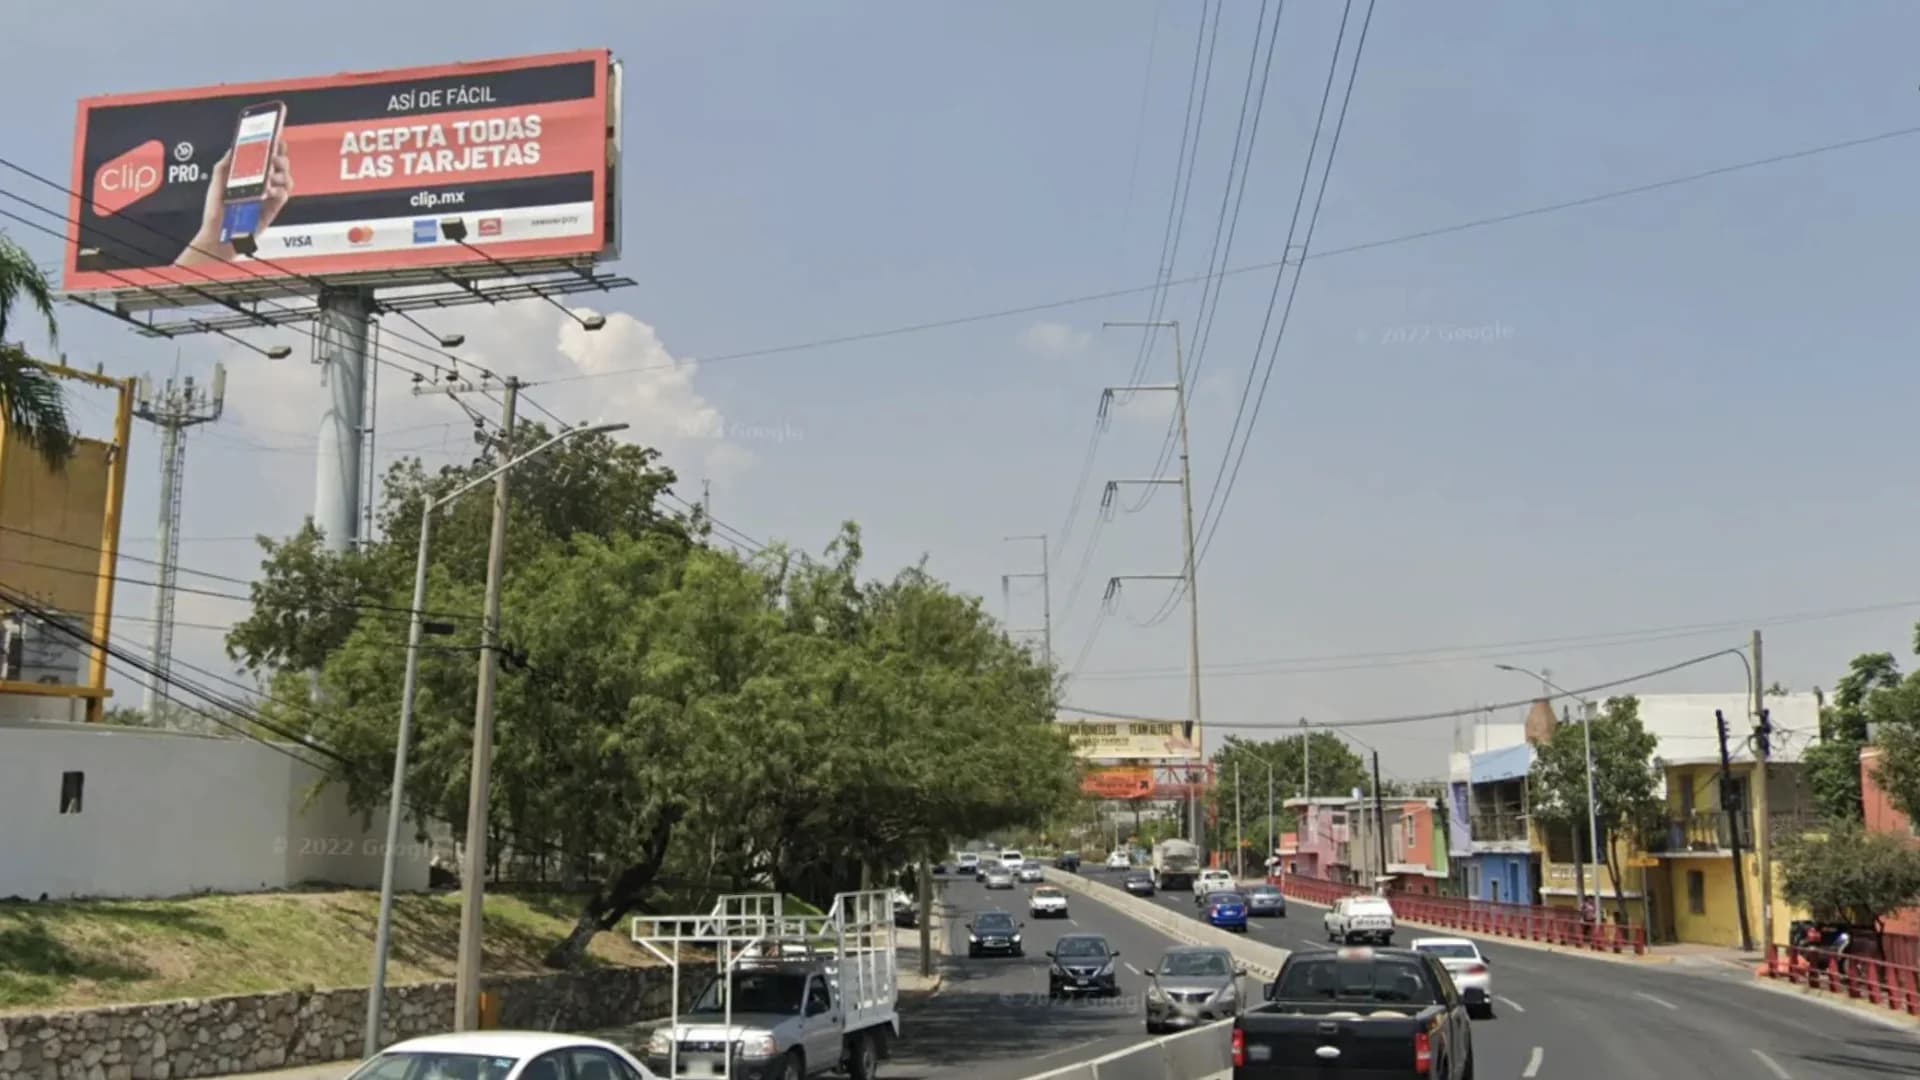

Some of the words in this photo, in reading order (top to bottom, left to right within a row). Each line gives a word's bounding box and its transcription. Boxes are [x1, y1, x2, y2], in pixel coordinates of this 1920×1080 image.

[387, 90, 415, 111] ASÍ
[419, 90, 443, 109] DE
[447, 85, 496, 105] FÁCIL
[340, 124, 447, 155] ACEPTA
[453, 115, 542, 145] TODAS
[340, 155, 394, 180] LAS
[400, 142, 541, 176] TARJETAS
[101, 162, 156, 193] clip
[410, 190, 465, 208] clip.mx
[282, 235, 312, 248] VISA
